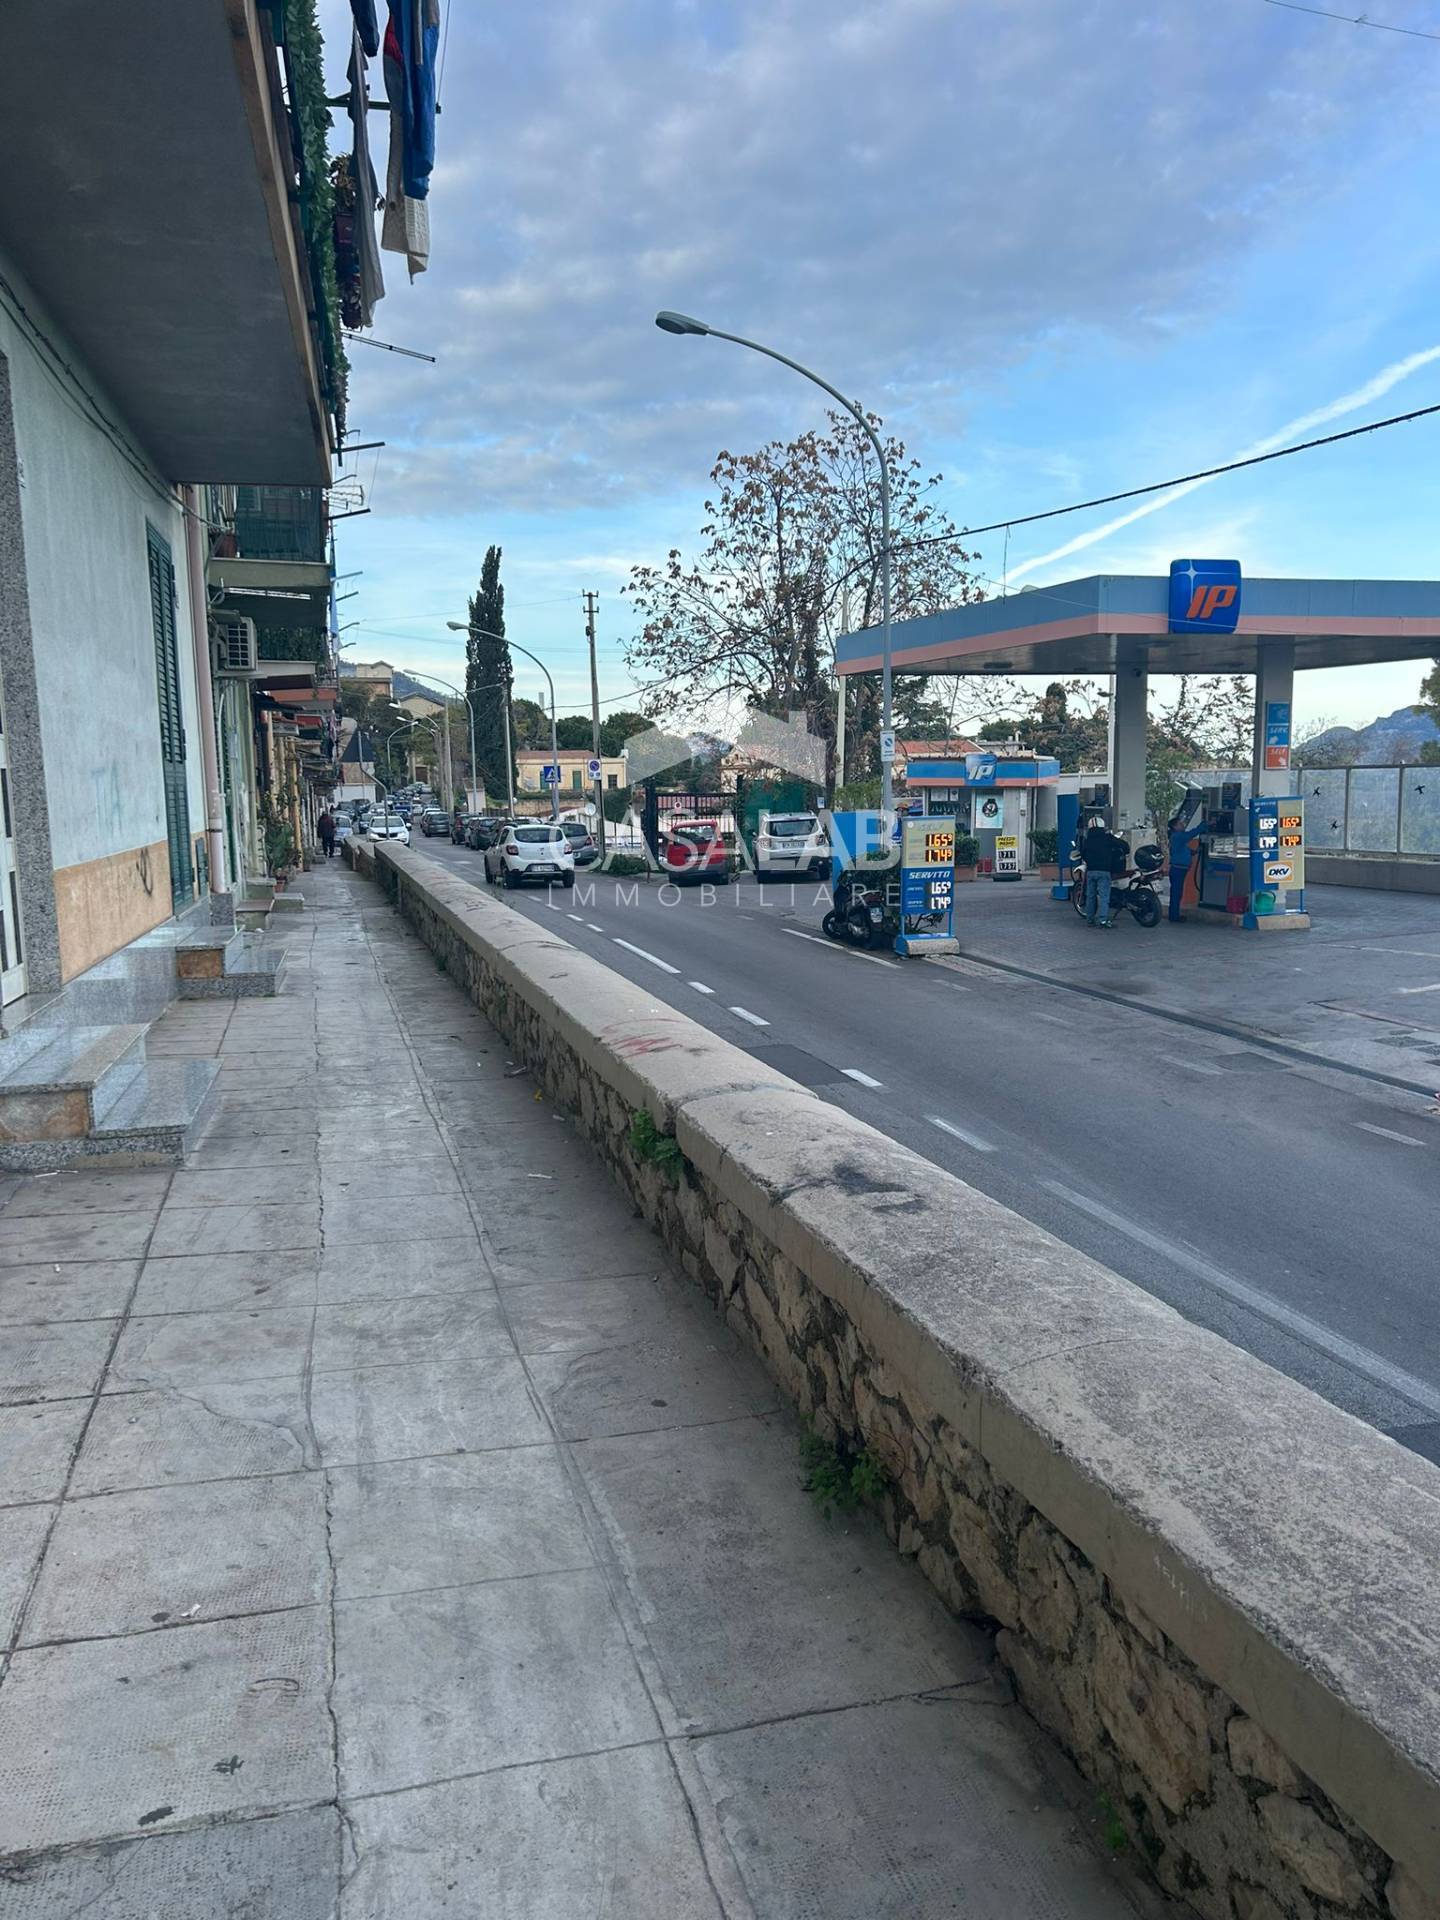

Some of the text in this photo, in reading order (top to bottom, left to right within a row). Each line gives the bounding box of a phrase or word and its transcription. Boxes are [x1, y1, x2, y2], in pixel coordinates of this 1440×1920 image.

[1186, 585, 1237, 619] IP
[968, 765, 994, 780] IP
[909, 870, 951, 880] SERVITO
[1269, 868, 1289, 876] DKV
